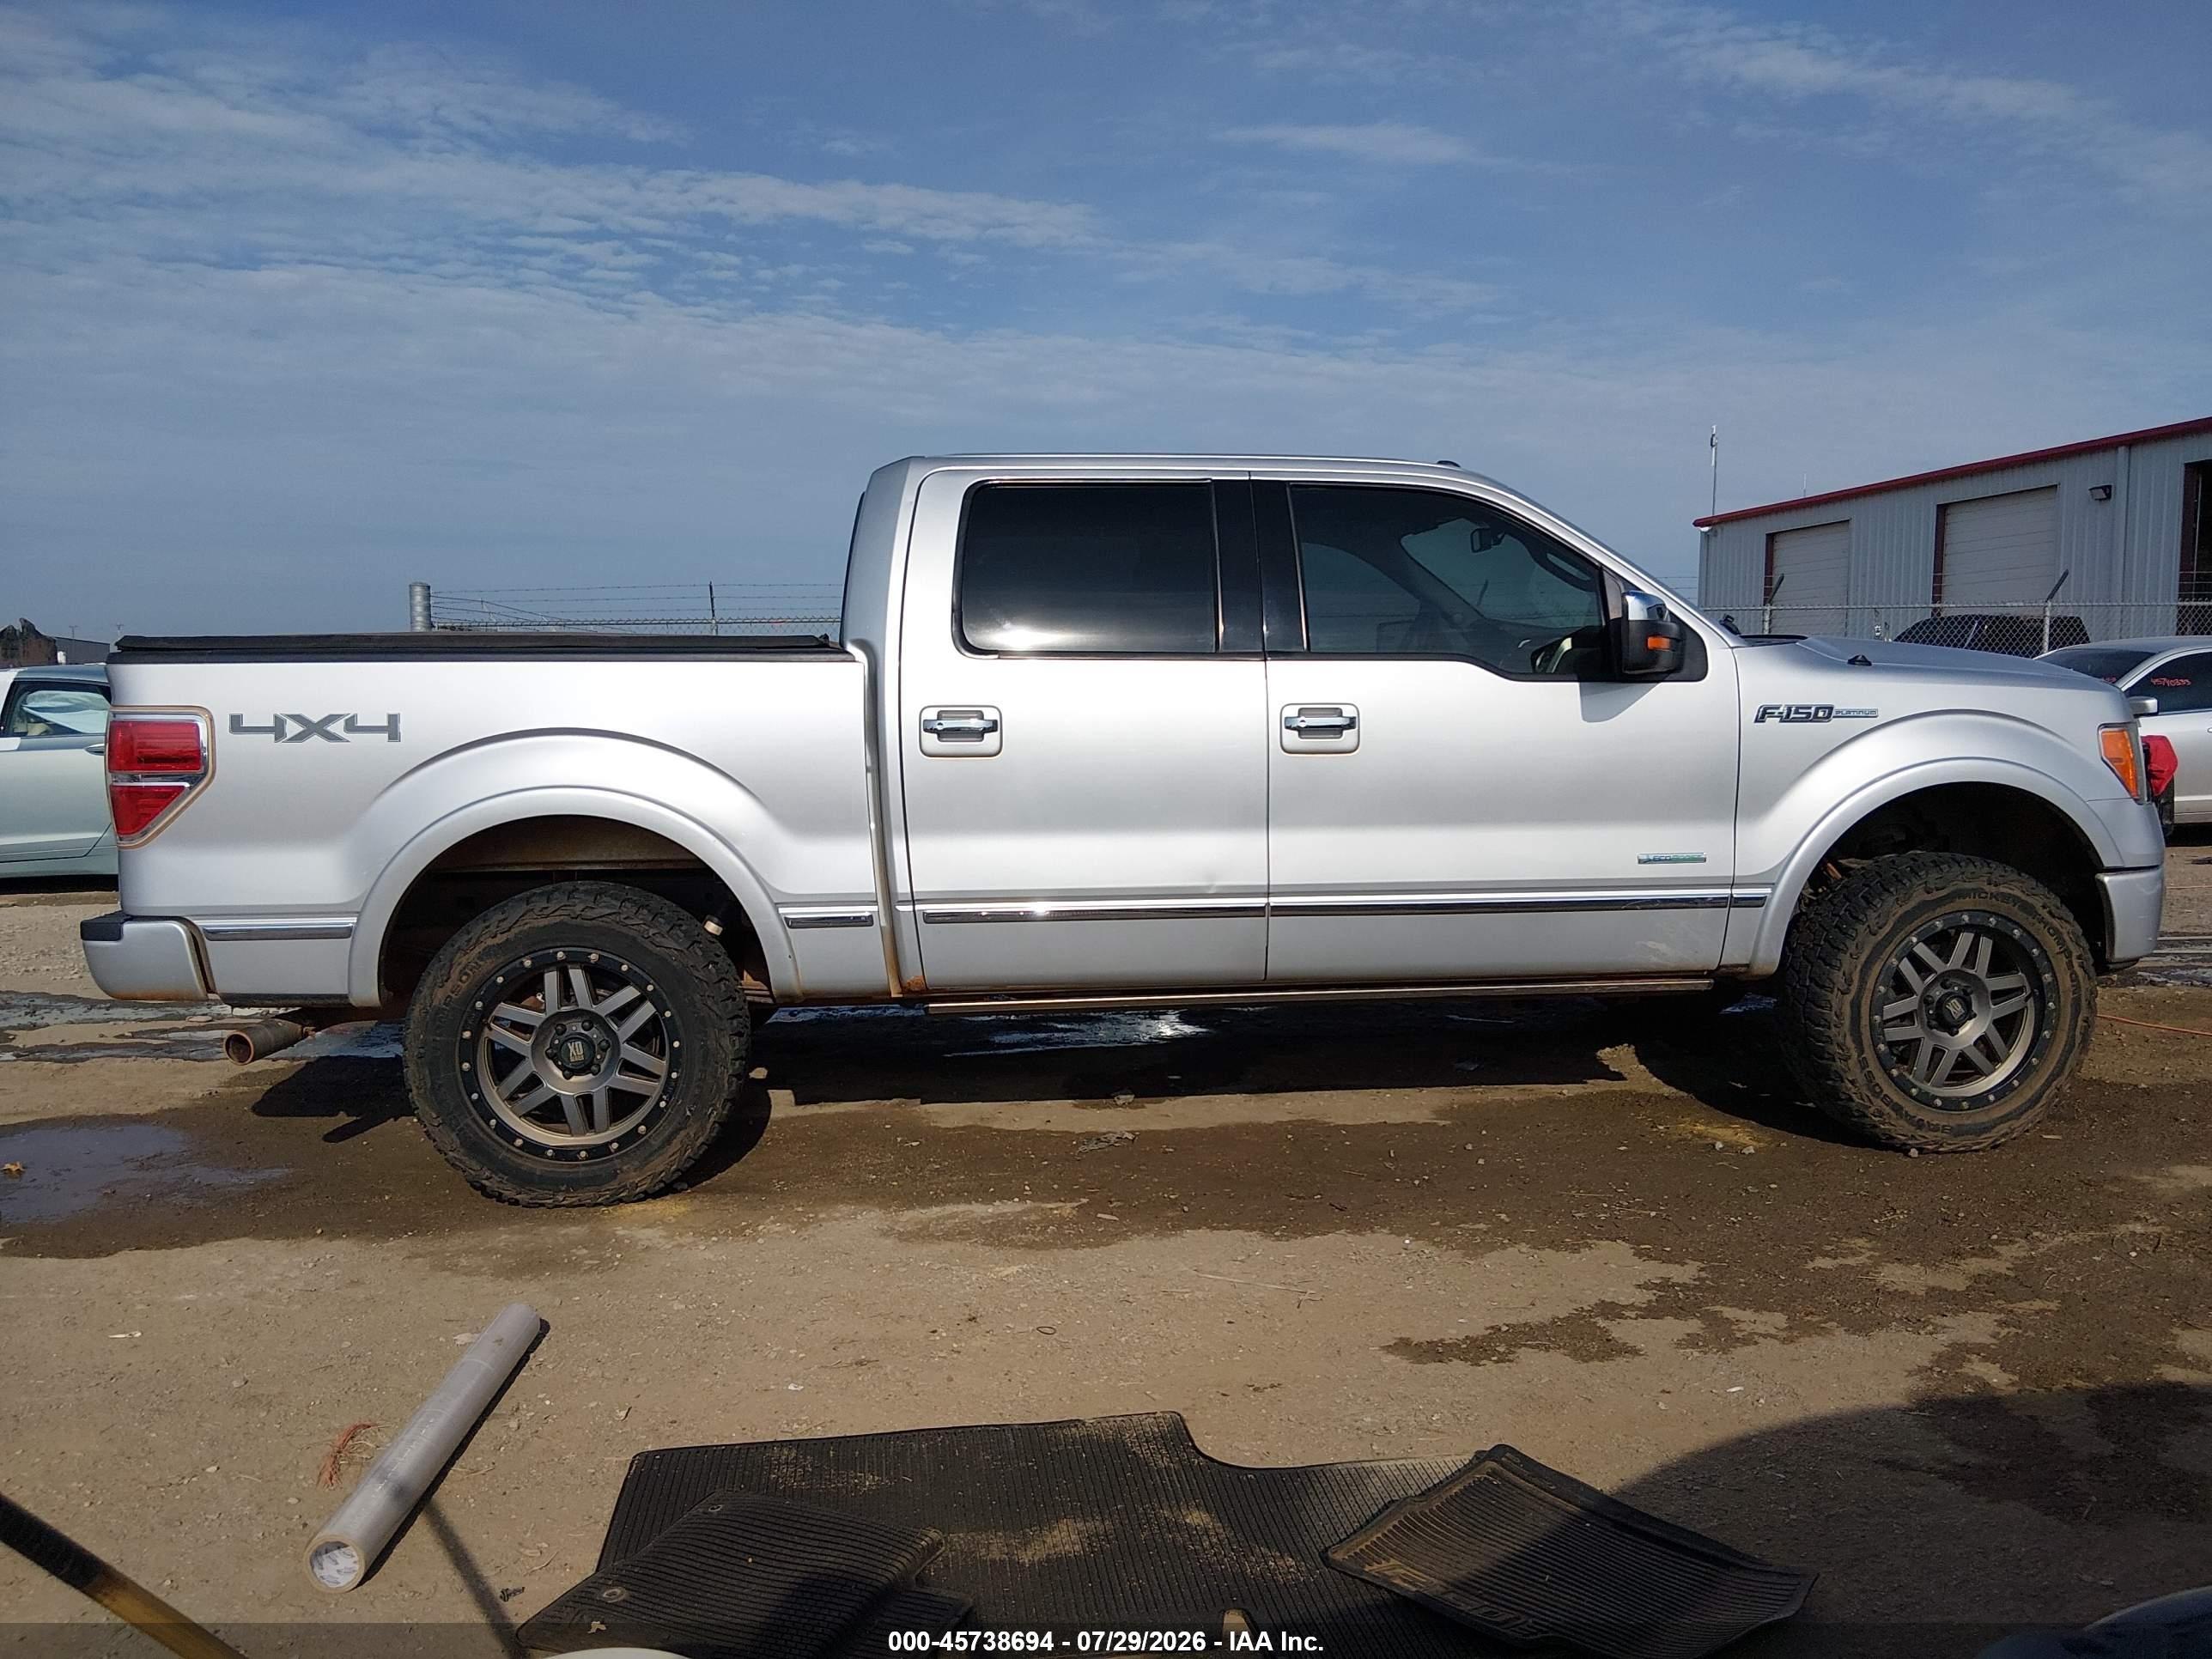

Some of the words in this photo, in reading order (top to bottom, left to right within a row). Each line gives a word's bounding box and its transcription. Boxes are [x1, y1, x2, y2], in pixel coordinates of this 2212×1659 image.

[1753, 703, 1834, 724] F-150
[228, 713, 401, 744] 4X4
[1959, 890, 2019, 908] MICKEY
